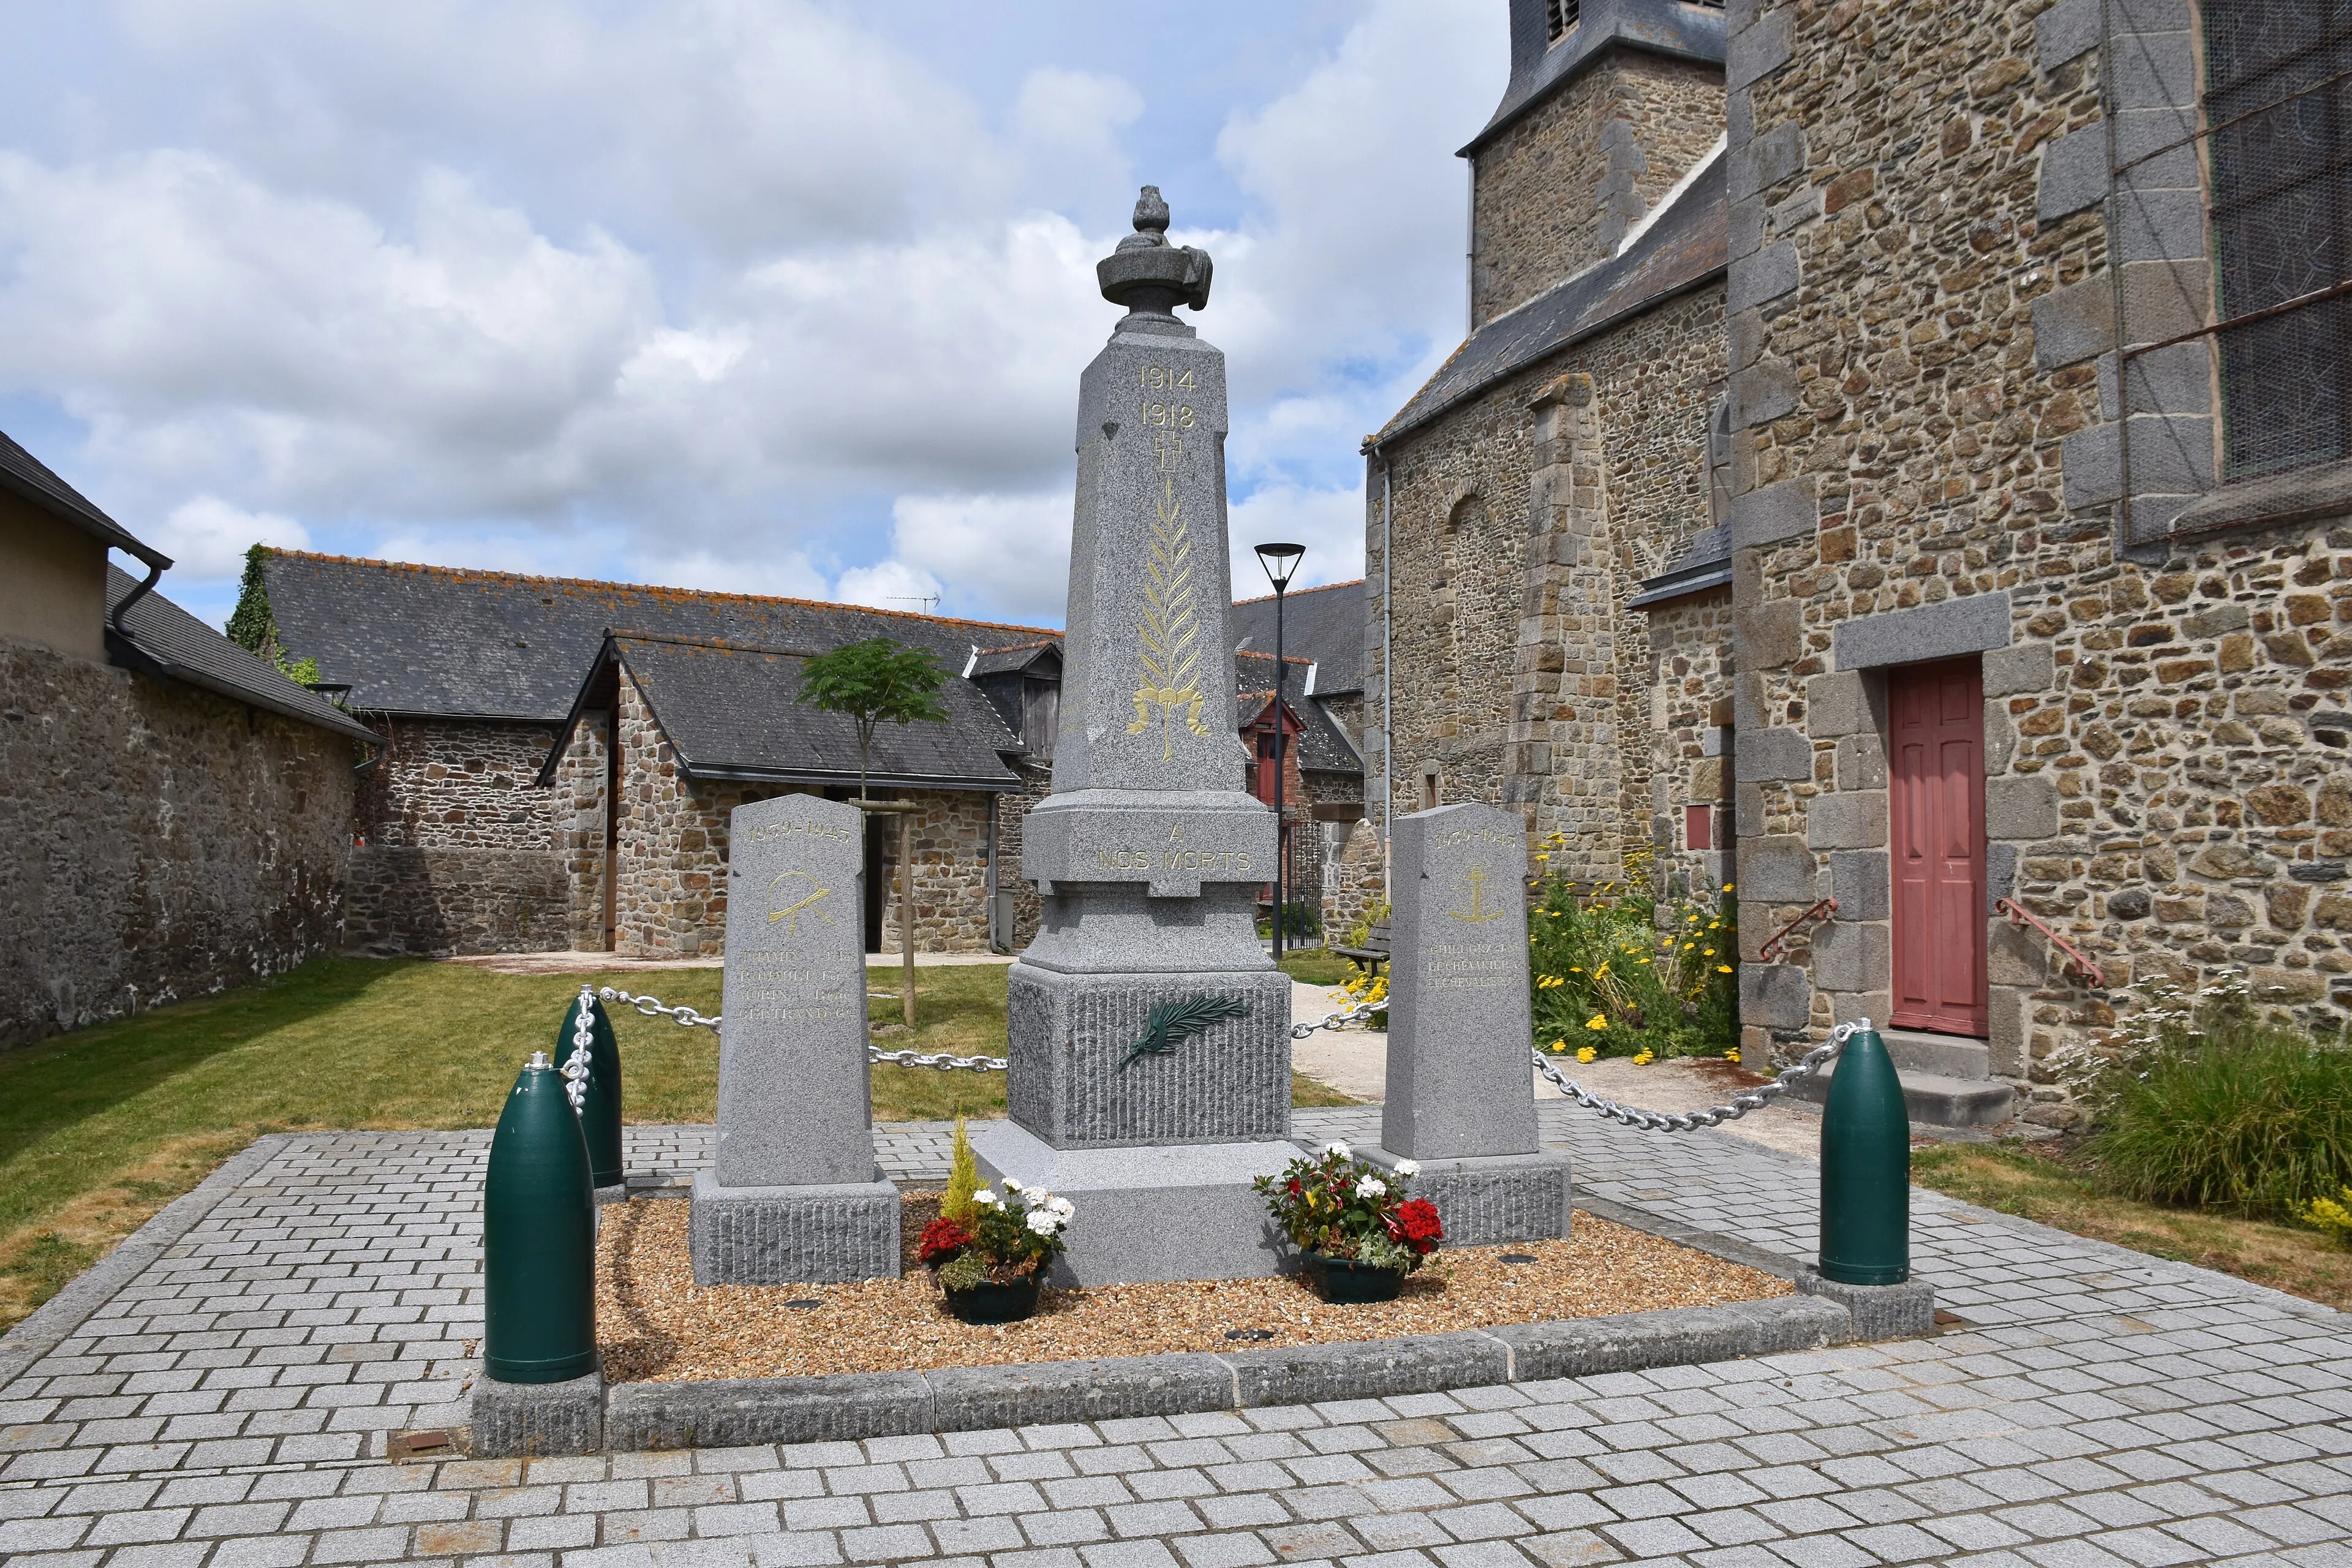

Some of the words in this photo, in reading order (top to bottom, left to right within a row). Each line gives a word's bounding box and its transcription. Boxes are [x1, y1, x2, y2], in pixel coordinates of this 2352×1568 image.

[1140, 366, 1196, 391] 1914
[1142, 402, 1195, 428] 1918
[1167, 823, 1184, 842] A
[1098, 851, 1150, 870] NOS
[1163, 851, 1251, 870] MORTS
